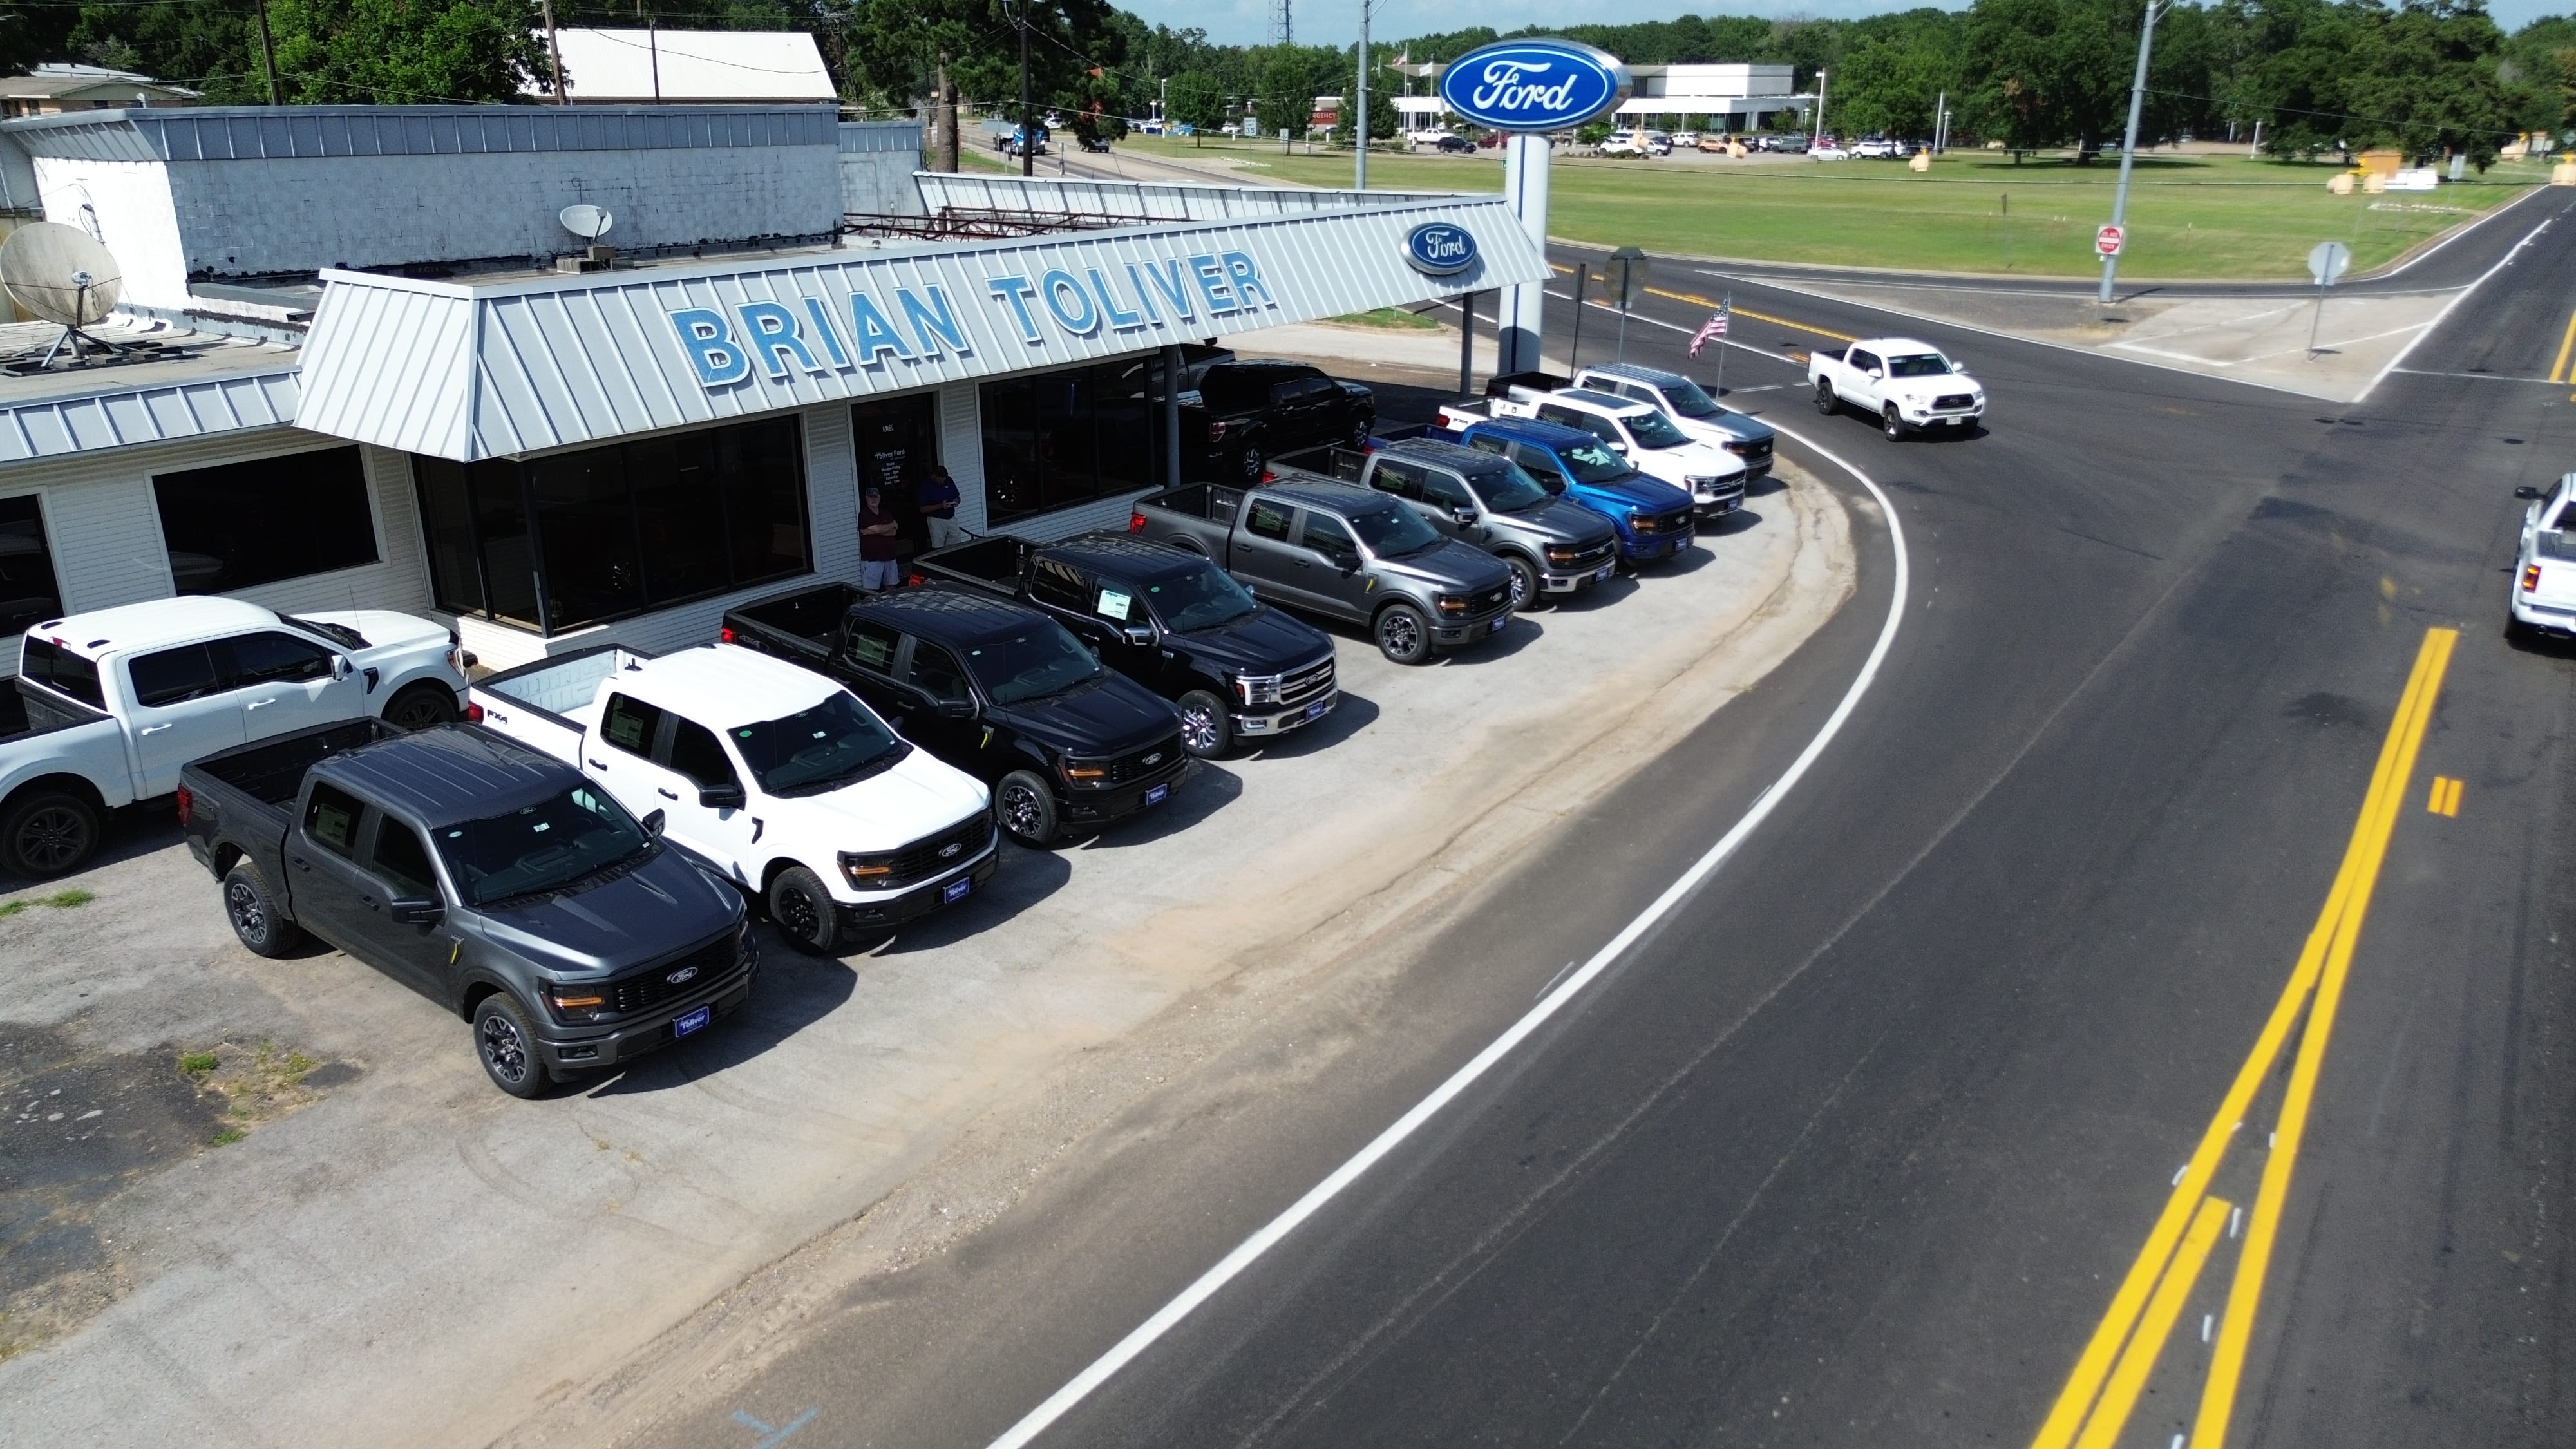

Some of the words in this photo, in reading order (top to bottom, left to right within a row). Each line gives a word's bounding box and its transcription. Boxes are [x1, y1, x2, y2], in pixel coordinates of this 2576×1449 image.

[1473, 61, 1577, 111] Ford
[1426, 231, 1466, 258] Ford
[667, 283, 969, 388] BRIAN
[985, 250, 1275, 344] TOLIVER
[676, 969, 693, 981] Ford
[680, 1014, 706, 1030] Toliver
